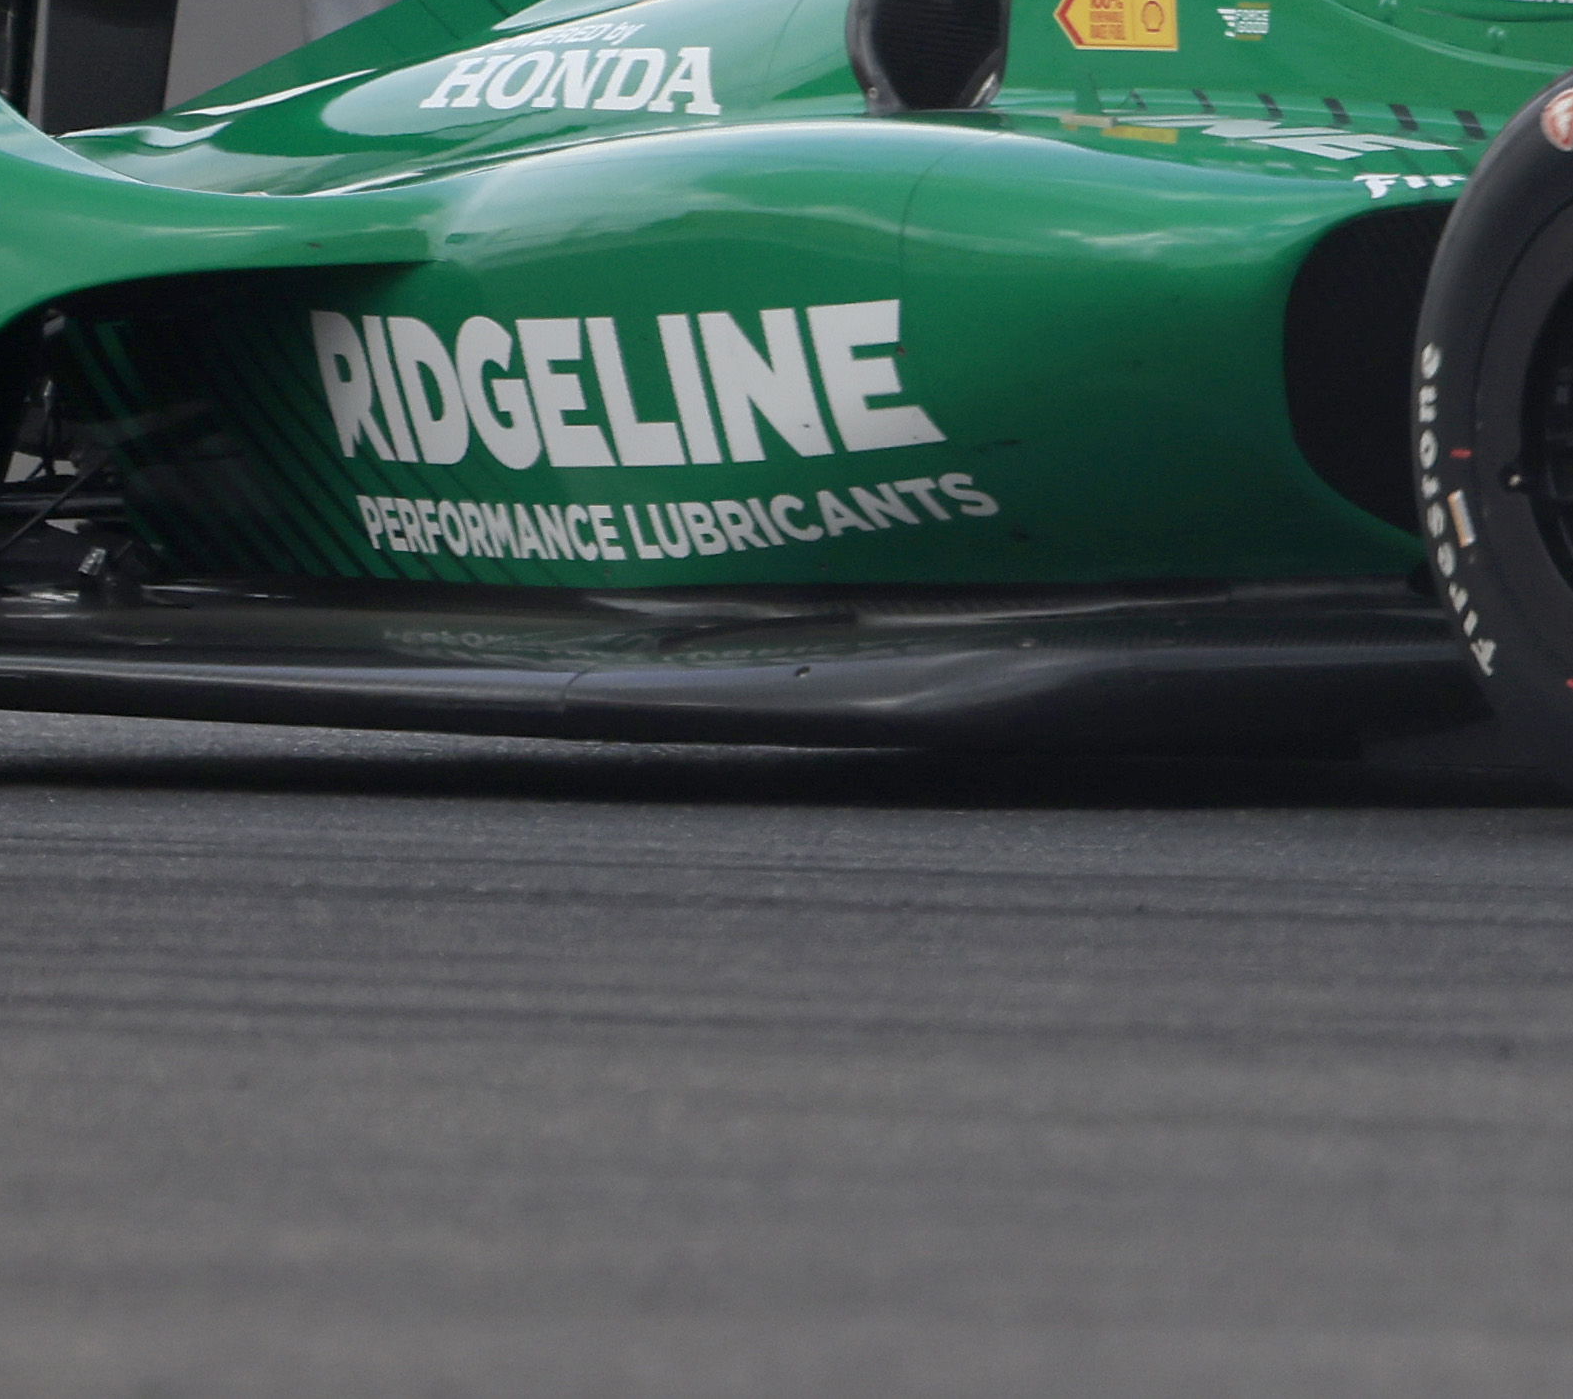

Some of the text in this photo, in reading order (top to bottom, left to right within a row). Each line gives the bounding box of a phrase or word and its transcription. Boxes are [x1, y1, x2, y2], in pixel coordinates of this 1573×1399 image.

[419, 46, 724, 117] HONDA
[309, 298, 948, 472] RIDGELINE
[354, 471, 1002, 562] PERFORMANCE LUBRICANTS
